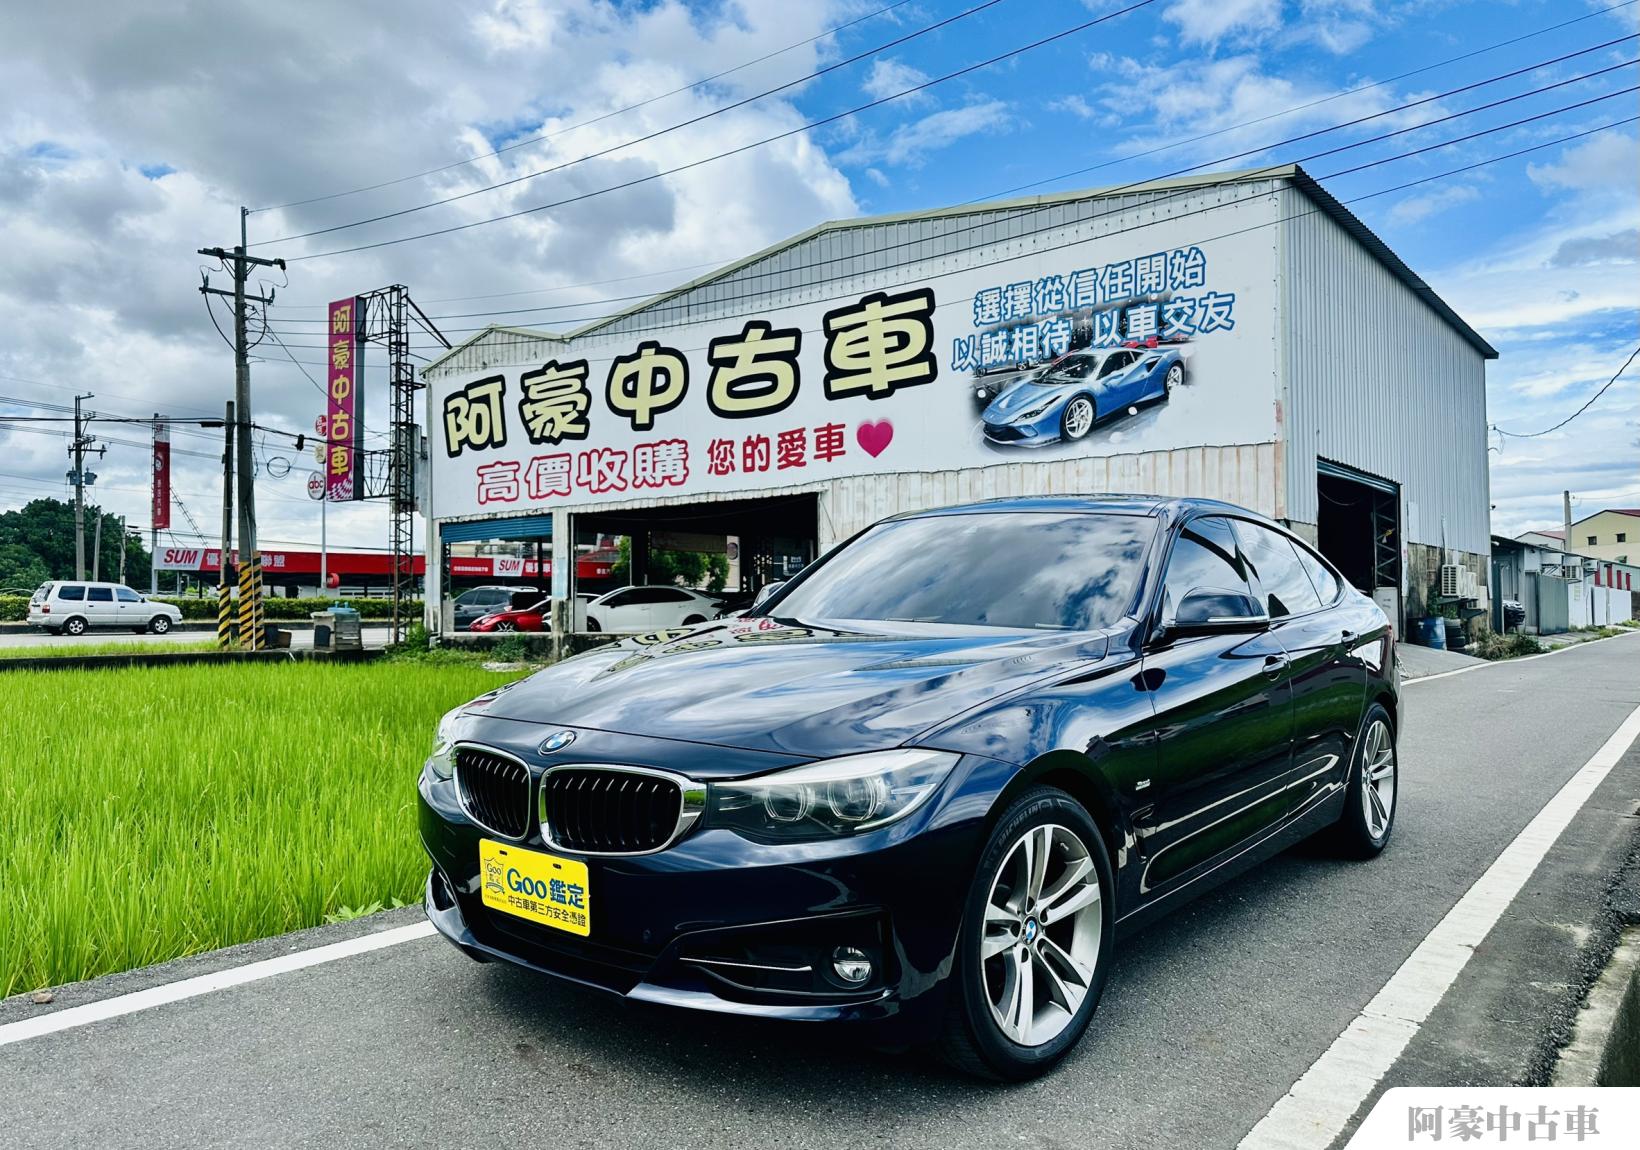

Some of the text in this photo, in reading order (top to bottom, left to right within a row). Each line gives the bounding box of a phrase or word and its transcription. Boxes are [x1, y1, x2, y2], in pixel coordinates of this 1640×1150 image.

[974, 247, 1206, 327] 選擇從信任開始
[951, 292, 1235, 372] 以誠相待 以車交友
[331, 305, 351, 475] 阿豪中古車
[444, 287, 938, 458] 阿豪中古車
[478, 422, 847, 505] 高價收購 您的愛車
[164, 549, 198, 564] SUM
[499, 560, 520, 572] SUM
[998, 803, 1040, 847] MICHELIN
